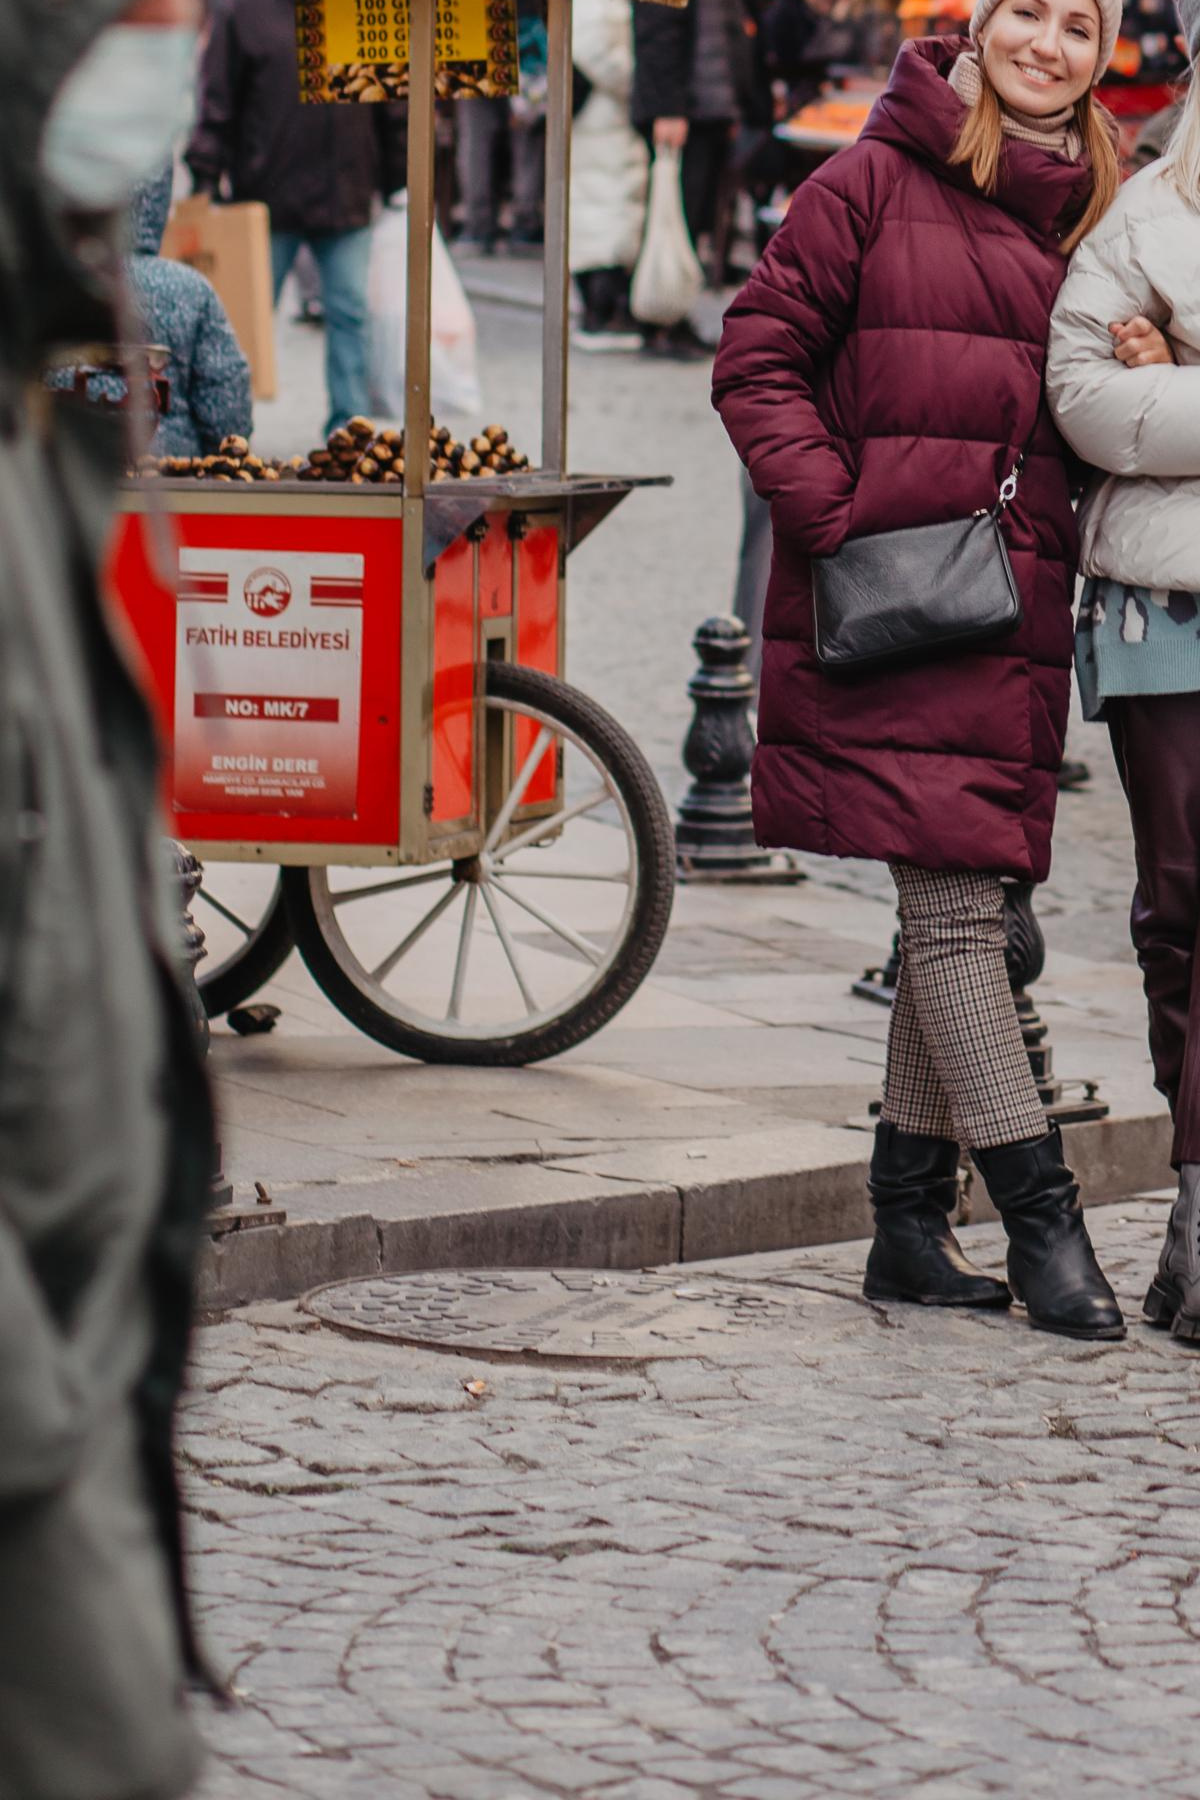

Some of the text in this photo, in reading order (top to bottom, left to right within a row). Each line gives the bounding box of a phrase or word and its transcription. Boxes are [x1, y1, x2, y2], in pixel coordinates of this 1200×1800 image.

[357, 11, 388, 26] 200
[394, 11, 410, 25] G
[357, 27, 388, 43] 300
[357, 45, 388, 60] 400
[186, 624, 350, 651] FATİH BELEDİYESİ
[225, 699, 309, 719] NO: MK/7
[211, 754, 318, 774] ENGİN DERE
